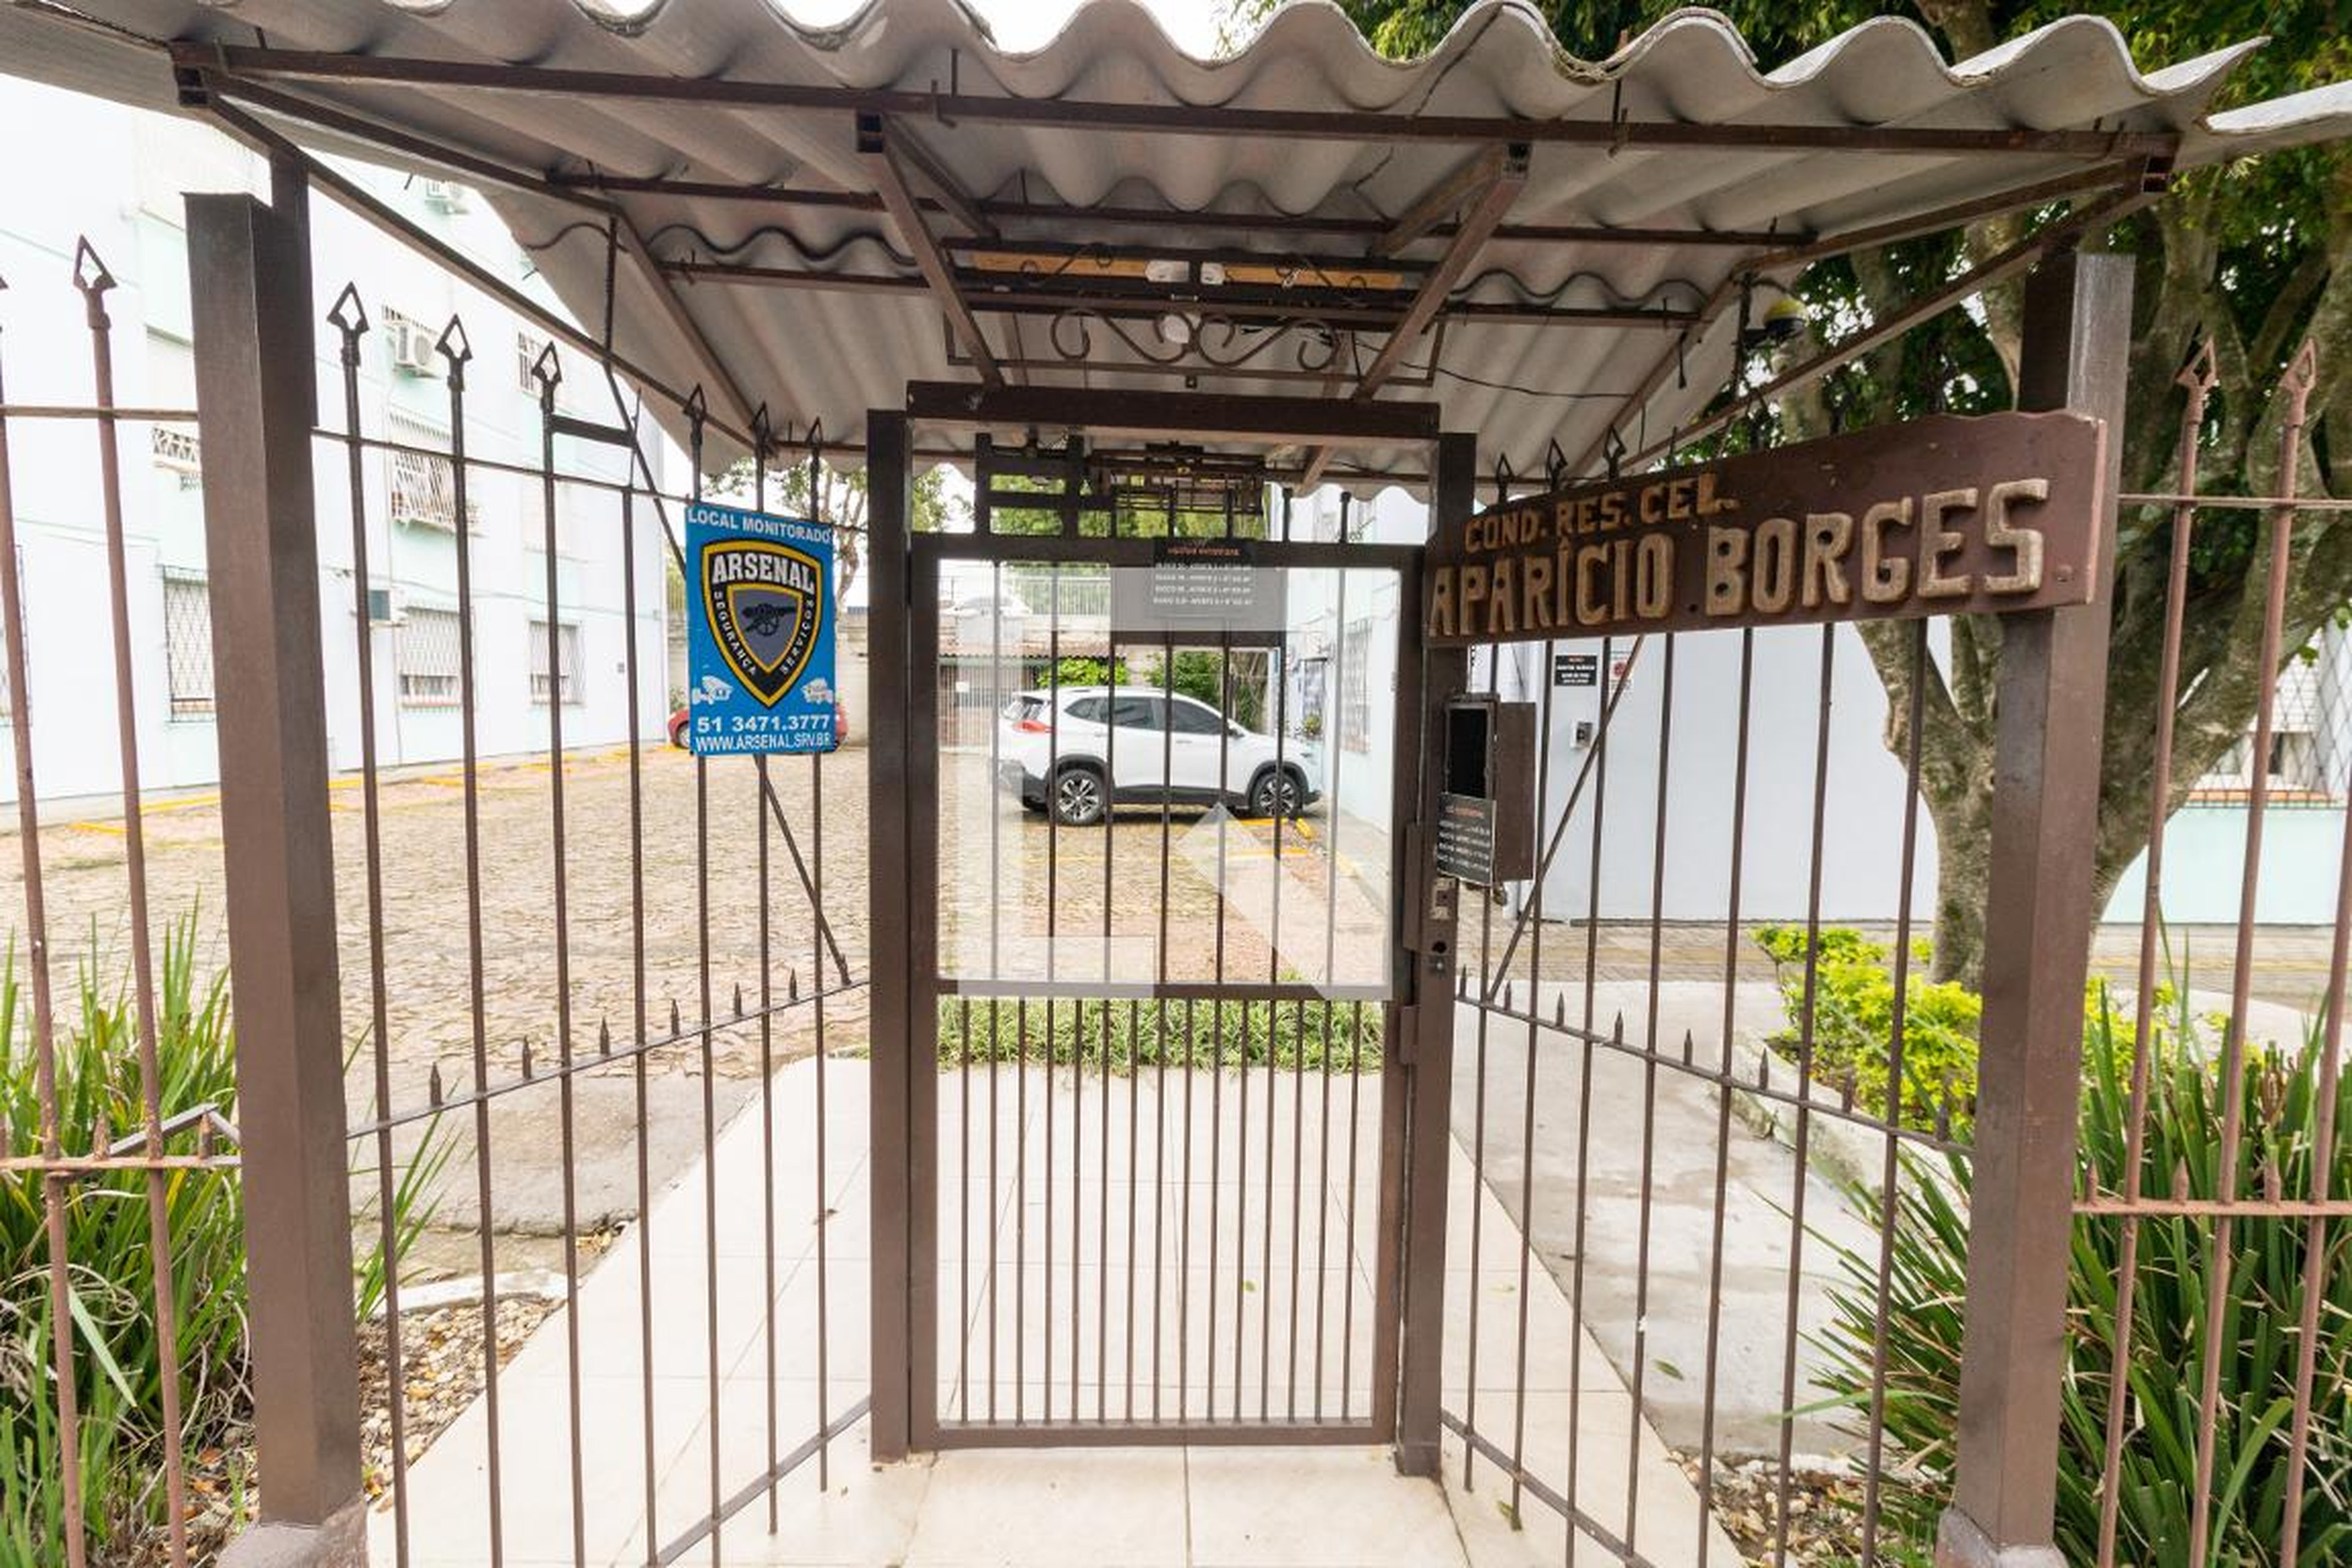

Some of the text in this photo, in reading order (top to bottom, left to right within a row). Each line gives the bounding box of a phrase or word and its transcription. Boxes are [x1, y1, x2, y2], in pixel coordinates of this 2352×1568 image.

[687, 508, 832, 543] LOCAL MONITORADO
[1465, 510, 1548, 552] COND.
[1556, 491, 1634, 537] RES.
[1706, 478, 2049, 615] BORGES
[712, 552, 815, 595] ARSENAL
[697, 714, 831, 733] 51 3471.3777
